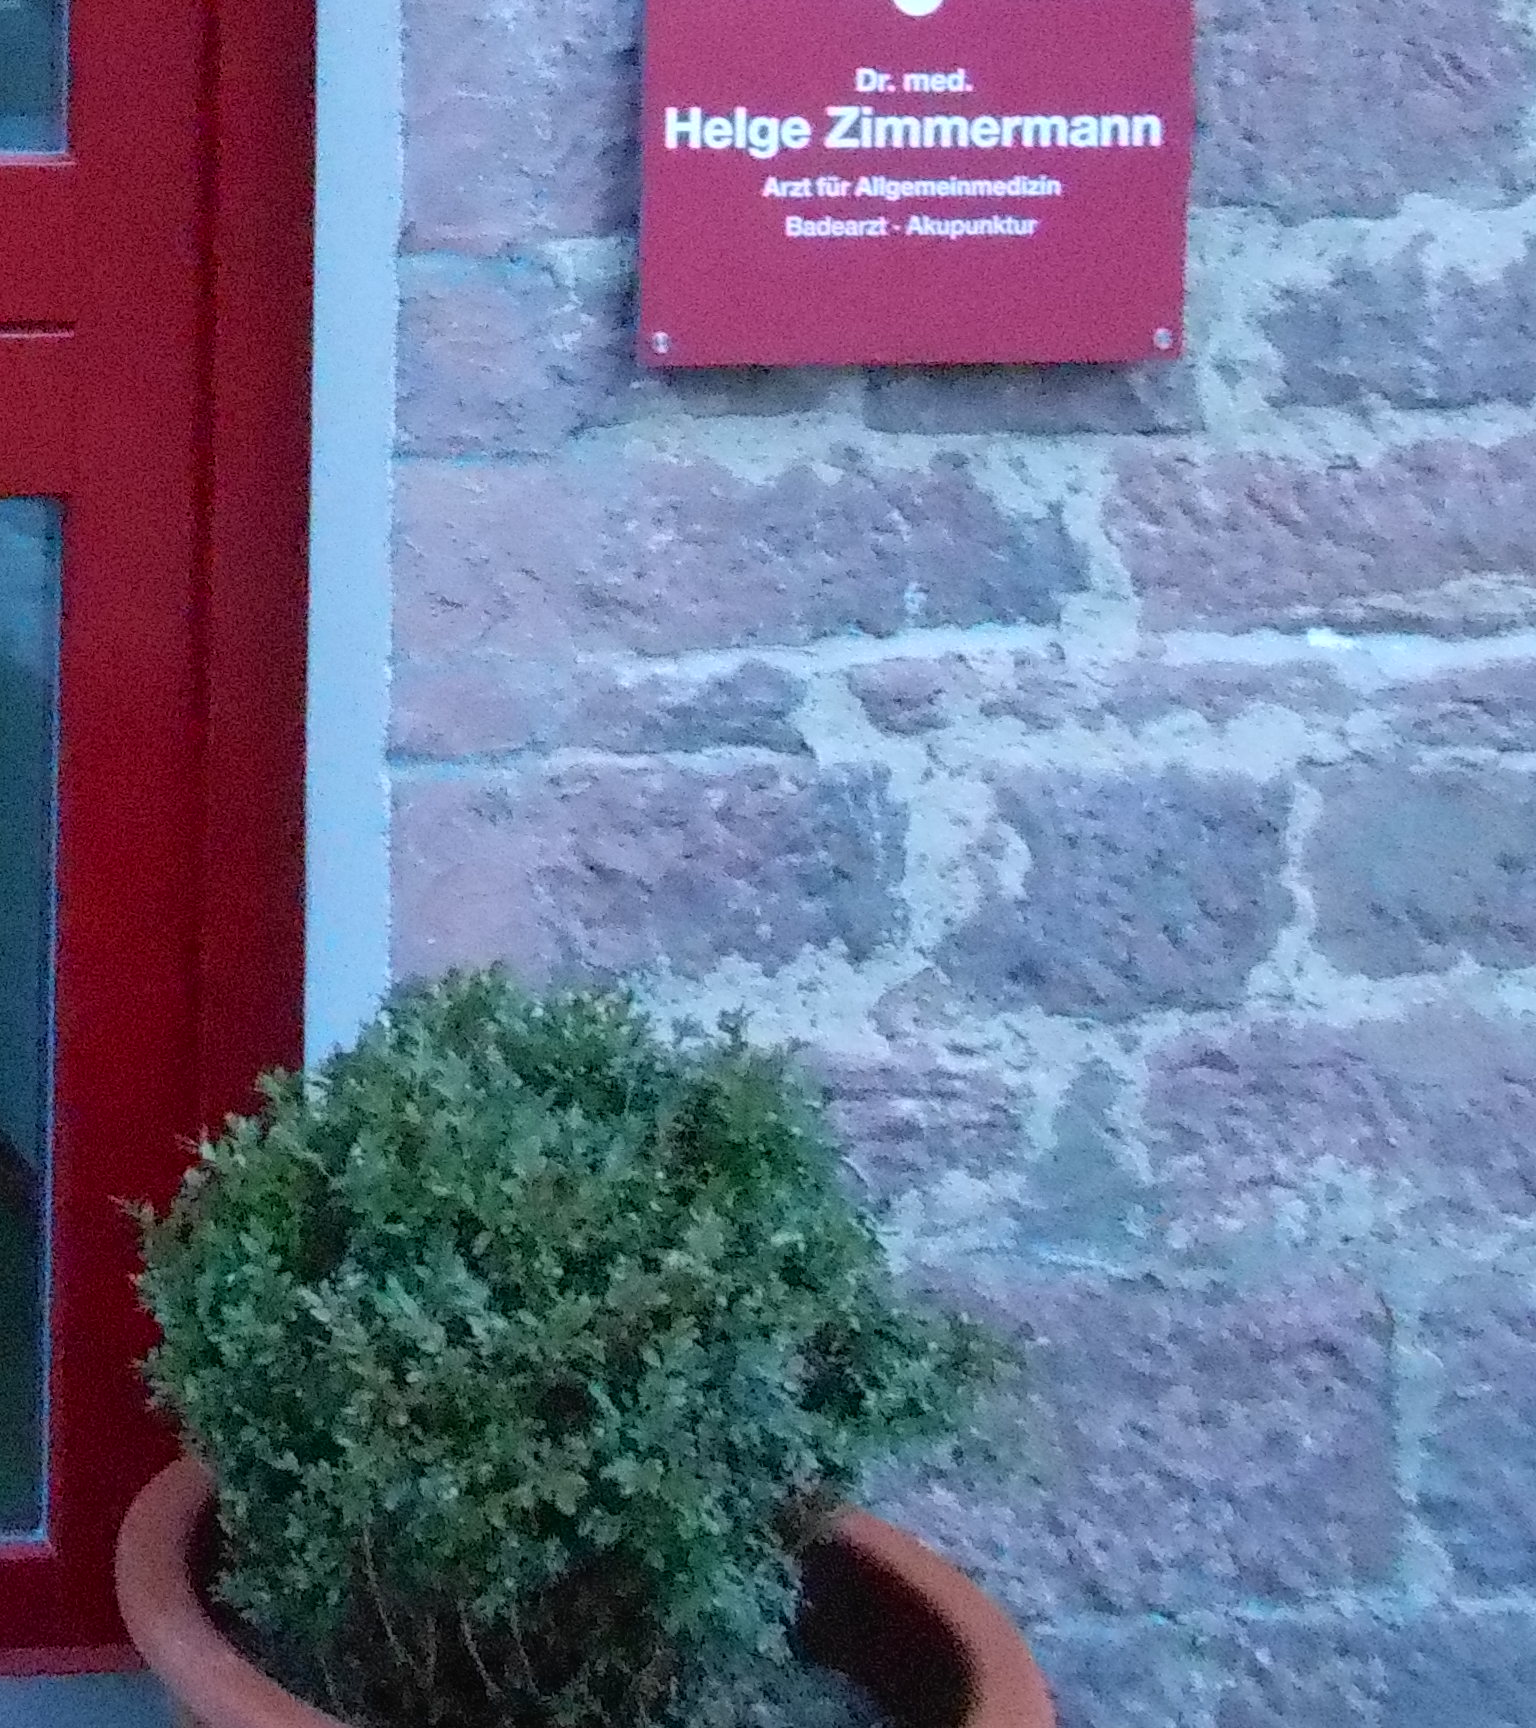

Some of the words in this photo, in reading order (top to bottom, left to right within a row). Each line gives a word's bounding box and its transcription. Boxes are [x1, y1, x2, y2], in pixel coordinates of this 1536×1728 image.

[855, 67, 896, 93] Dr.
[902, 67, 974, 93] med.
[664, 106, 811, 159] Helge
[825, 106, 1163, 149] Zimmermann
[762, 176, 812, 198] Arzt
[815, 175, 851, 198] für
[854, 175, 1063, 201] Allgemeinmedizin
[785, 215, 889, 238] Badearzt
[905, 215, 1039, 240] Akupunktur
